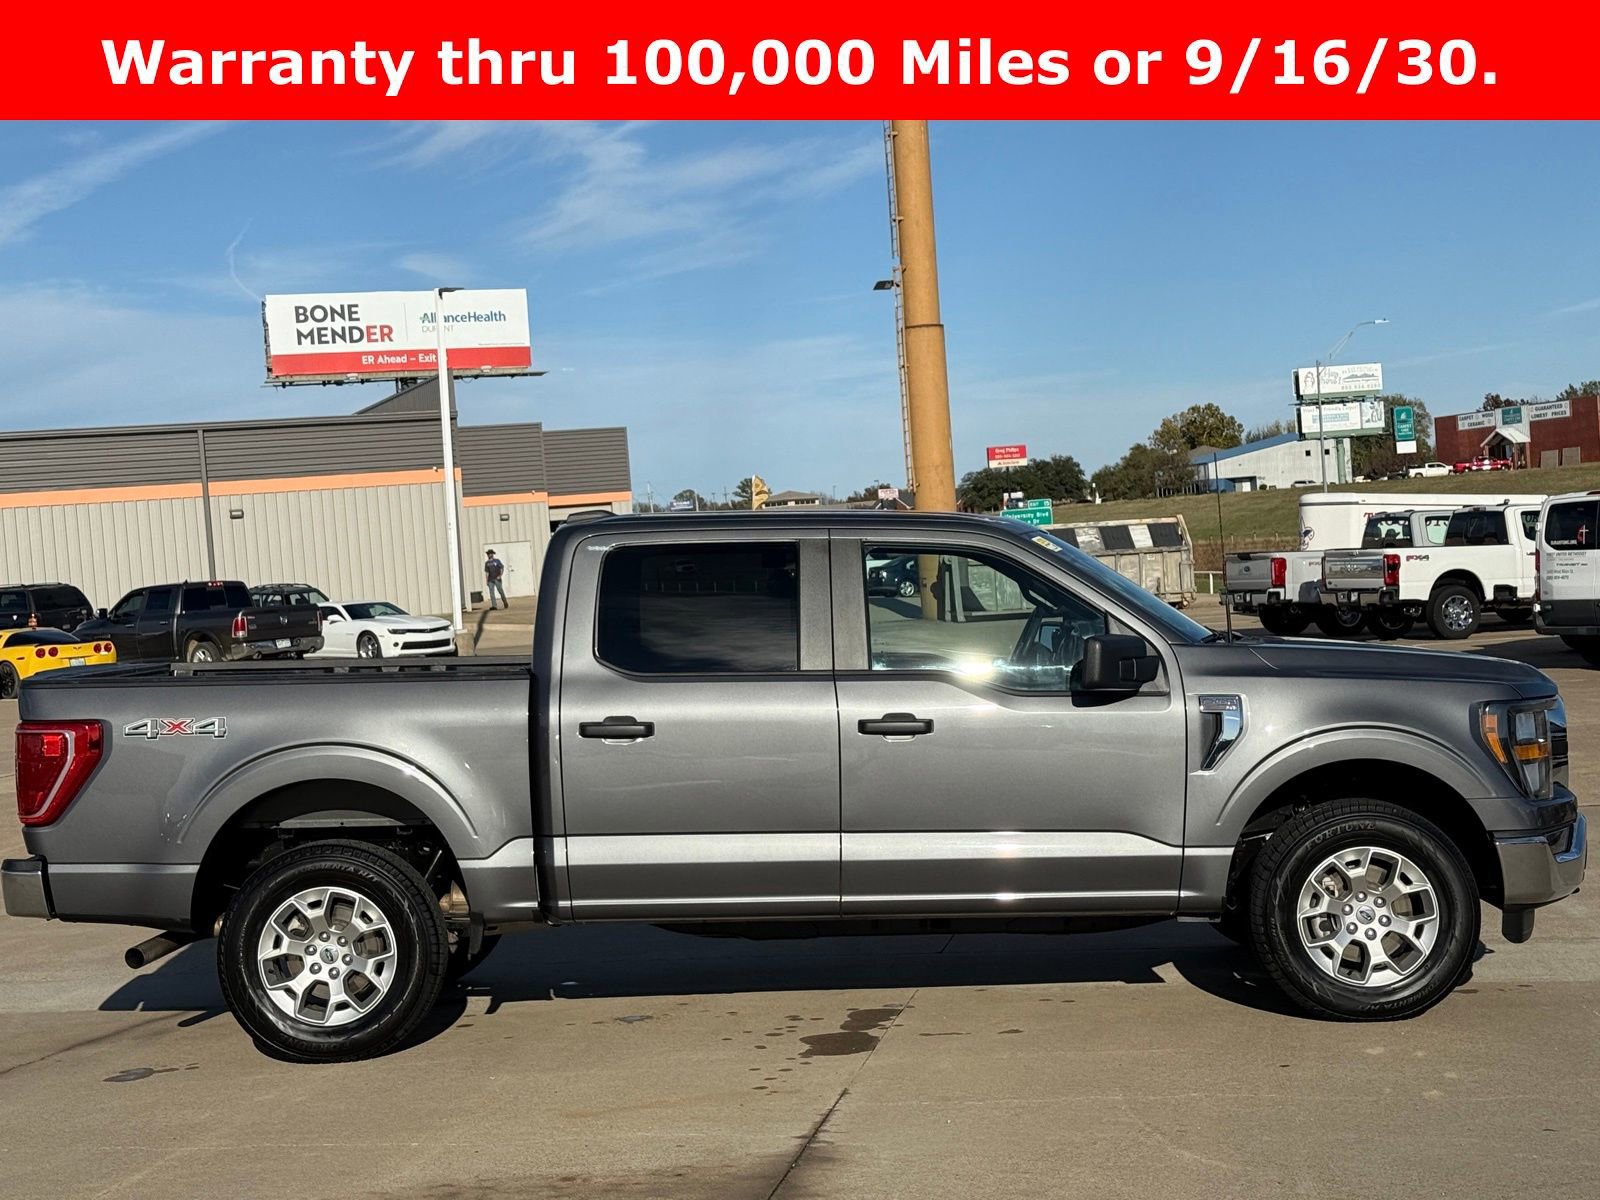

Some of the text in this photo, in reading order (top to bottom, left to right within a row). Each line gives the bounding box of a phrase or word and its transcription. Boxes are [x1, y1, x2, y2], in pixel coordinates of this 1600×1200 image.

[294, 304, 360, 323] BONE
[296, 325, 394, 345] MENDER
[361, 355, 375, 365] ER
[377, 354, 407, 364] Ahead
[418, 353, 437, 363] Exit
[1535, 402, 1563, 411] GUARANTEED
[1306, 823, 1377, 850] FORTUNE
